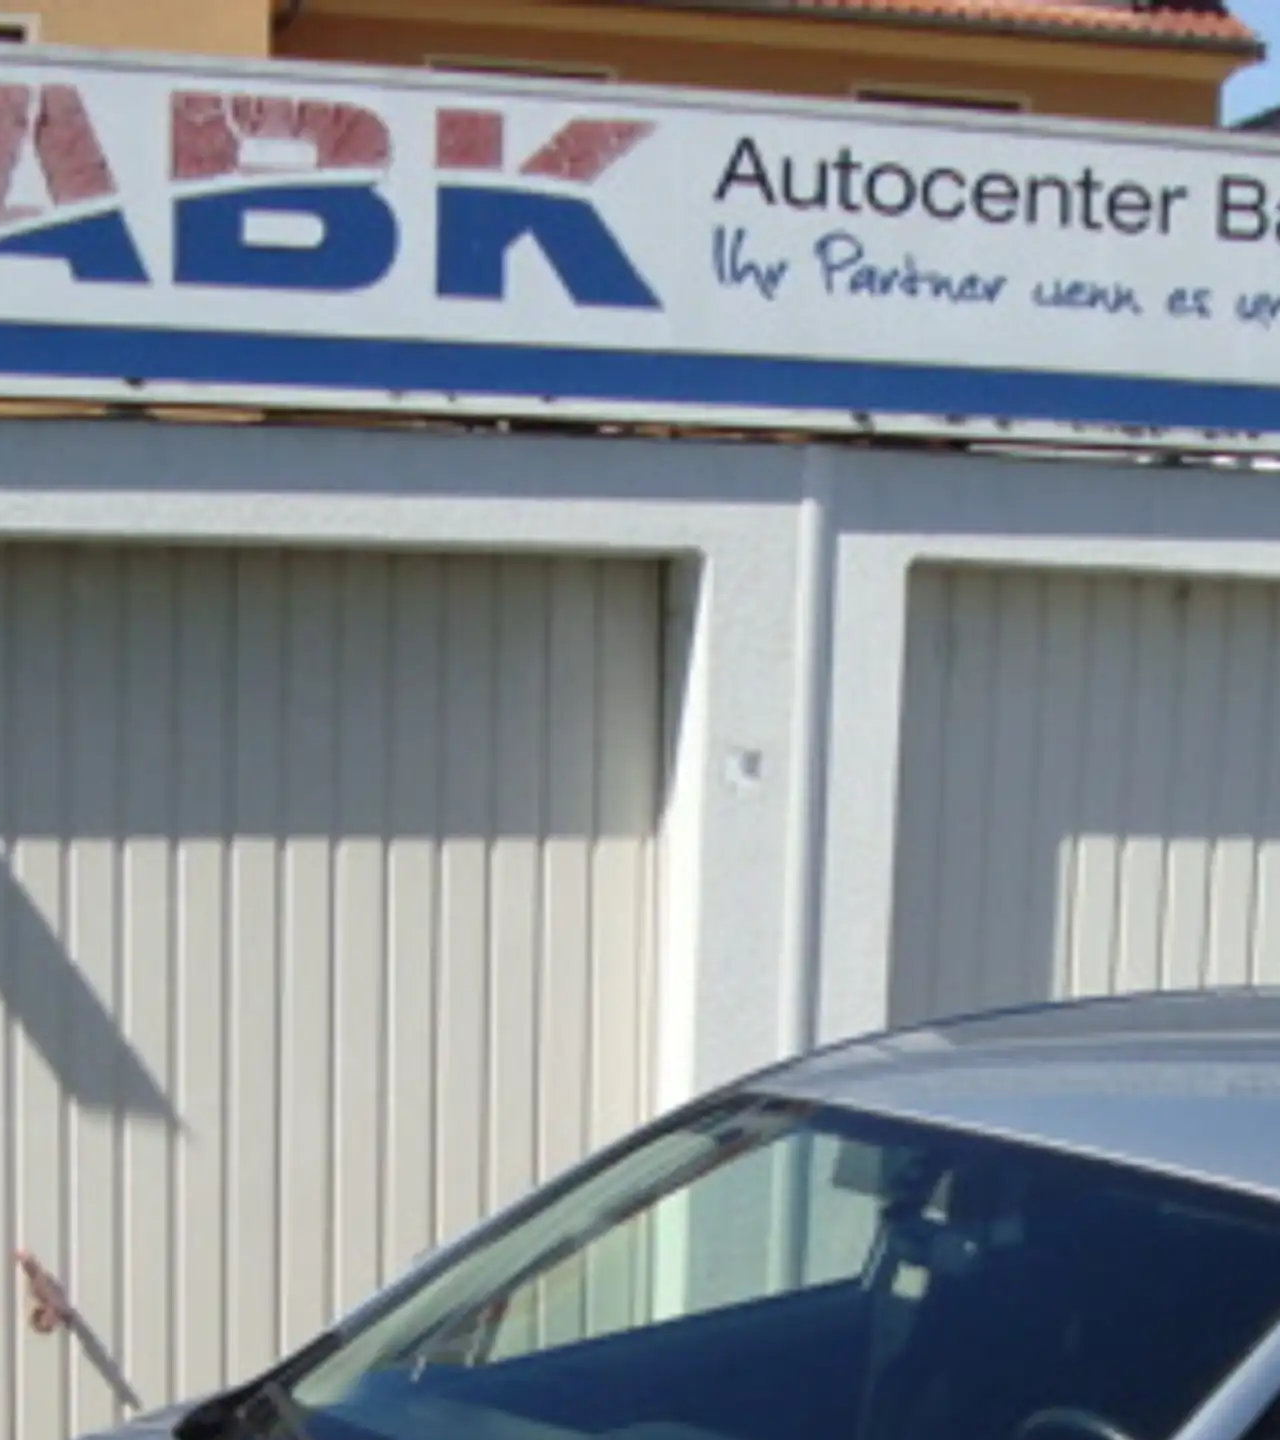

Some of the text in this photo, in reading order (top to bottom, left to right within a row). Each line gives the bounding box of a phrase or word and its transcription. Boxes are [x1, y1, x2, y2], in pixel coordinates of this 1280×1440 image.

[712, 134, 1189, 237] Autocenter
[711, 223, 790, 302] Ihr
[813, 230, 1009, 305] Partner
[1164, 286, 1212, 320] es
